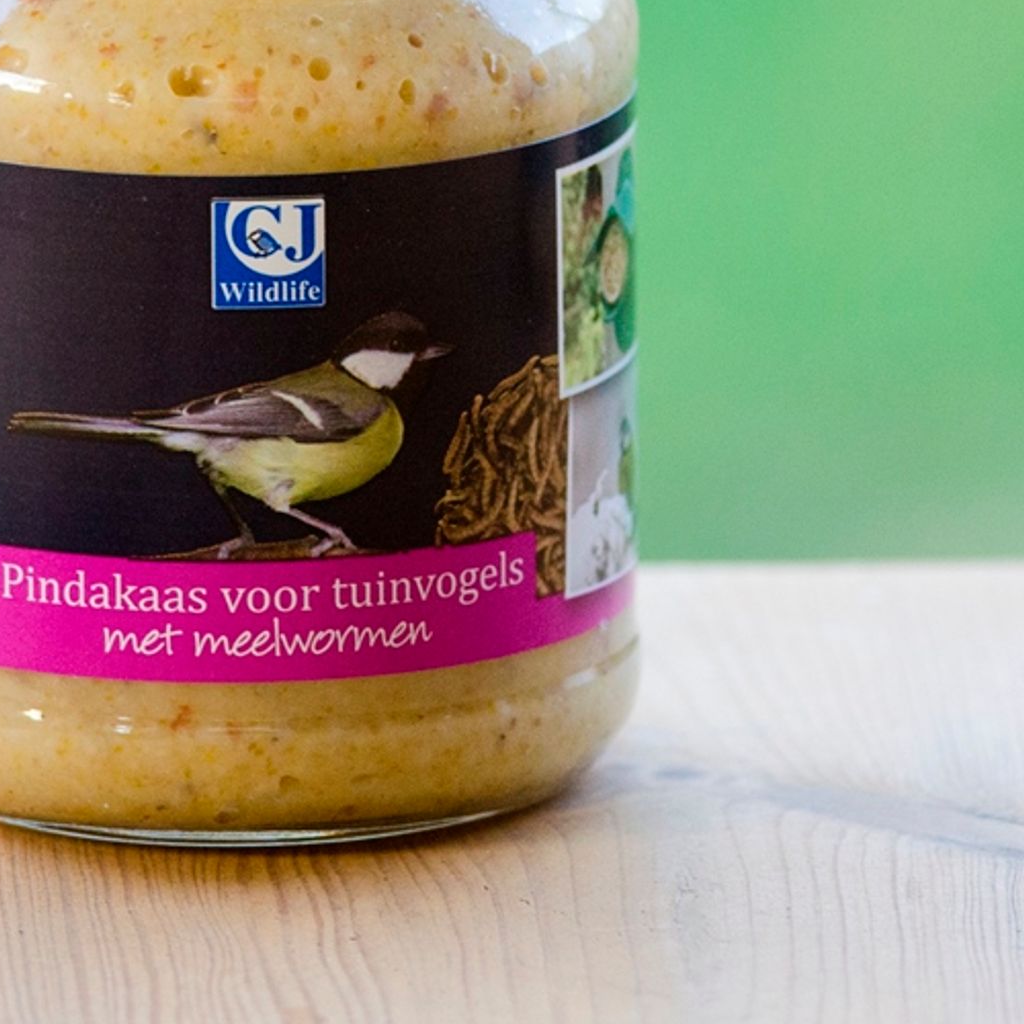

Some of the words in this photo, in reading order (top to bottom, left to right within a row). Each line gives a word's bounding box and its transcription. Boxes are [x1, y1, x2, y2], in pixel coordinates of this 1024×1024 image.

[231, 203, 322, 264] CJ
[219, 279, 321, 303] Wildlife
[1, 561, 208, 614] Pindakaas
[219, 585, 321, 615] voor
[331, 550, 524, 606] tuinvogels
[102, 623, 184, 657] met
[192, 616, 433, 658] meelwormen
